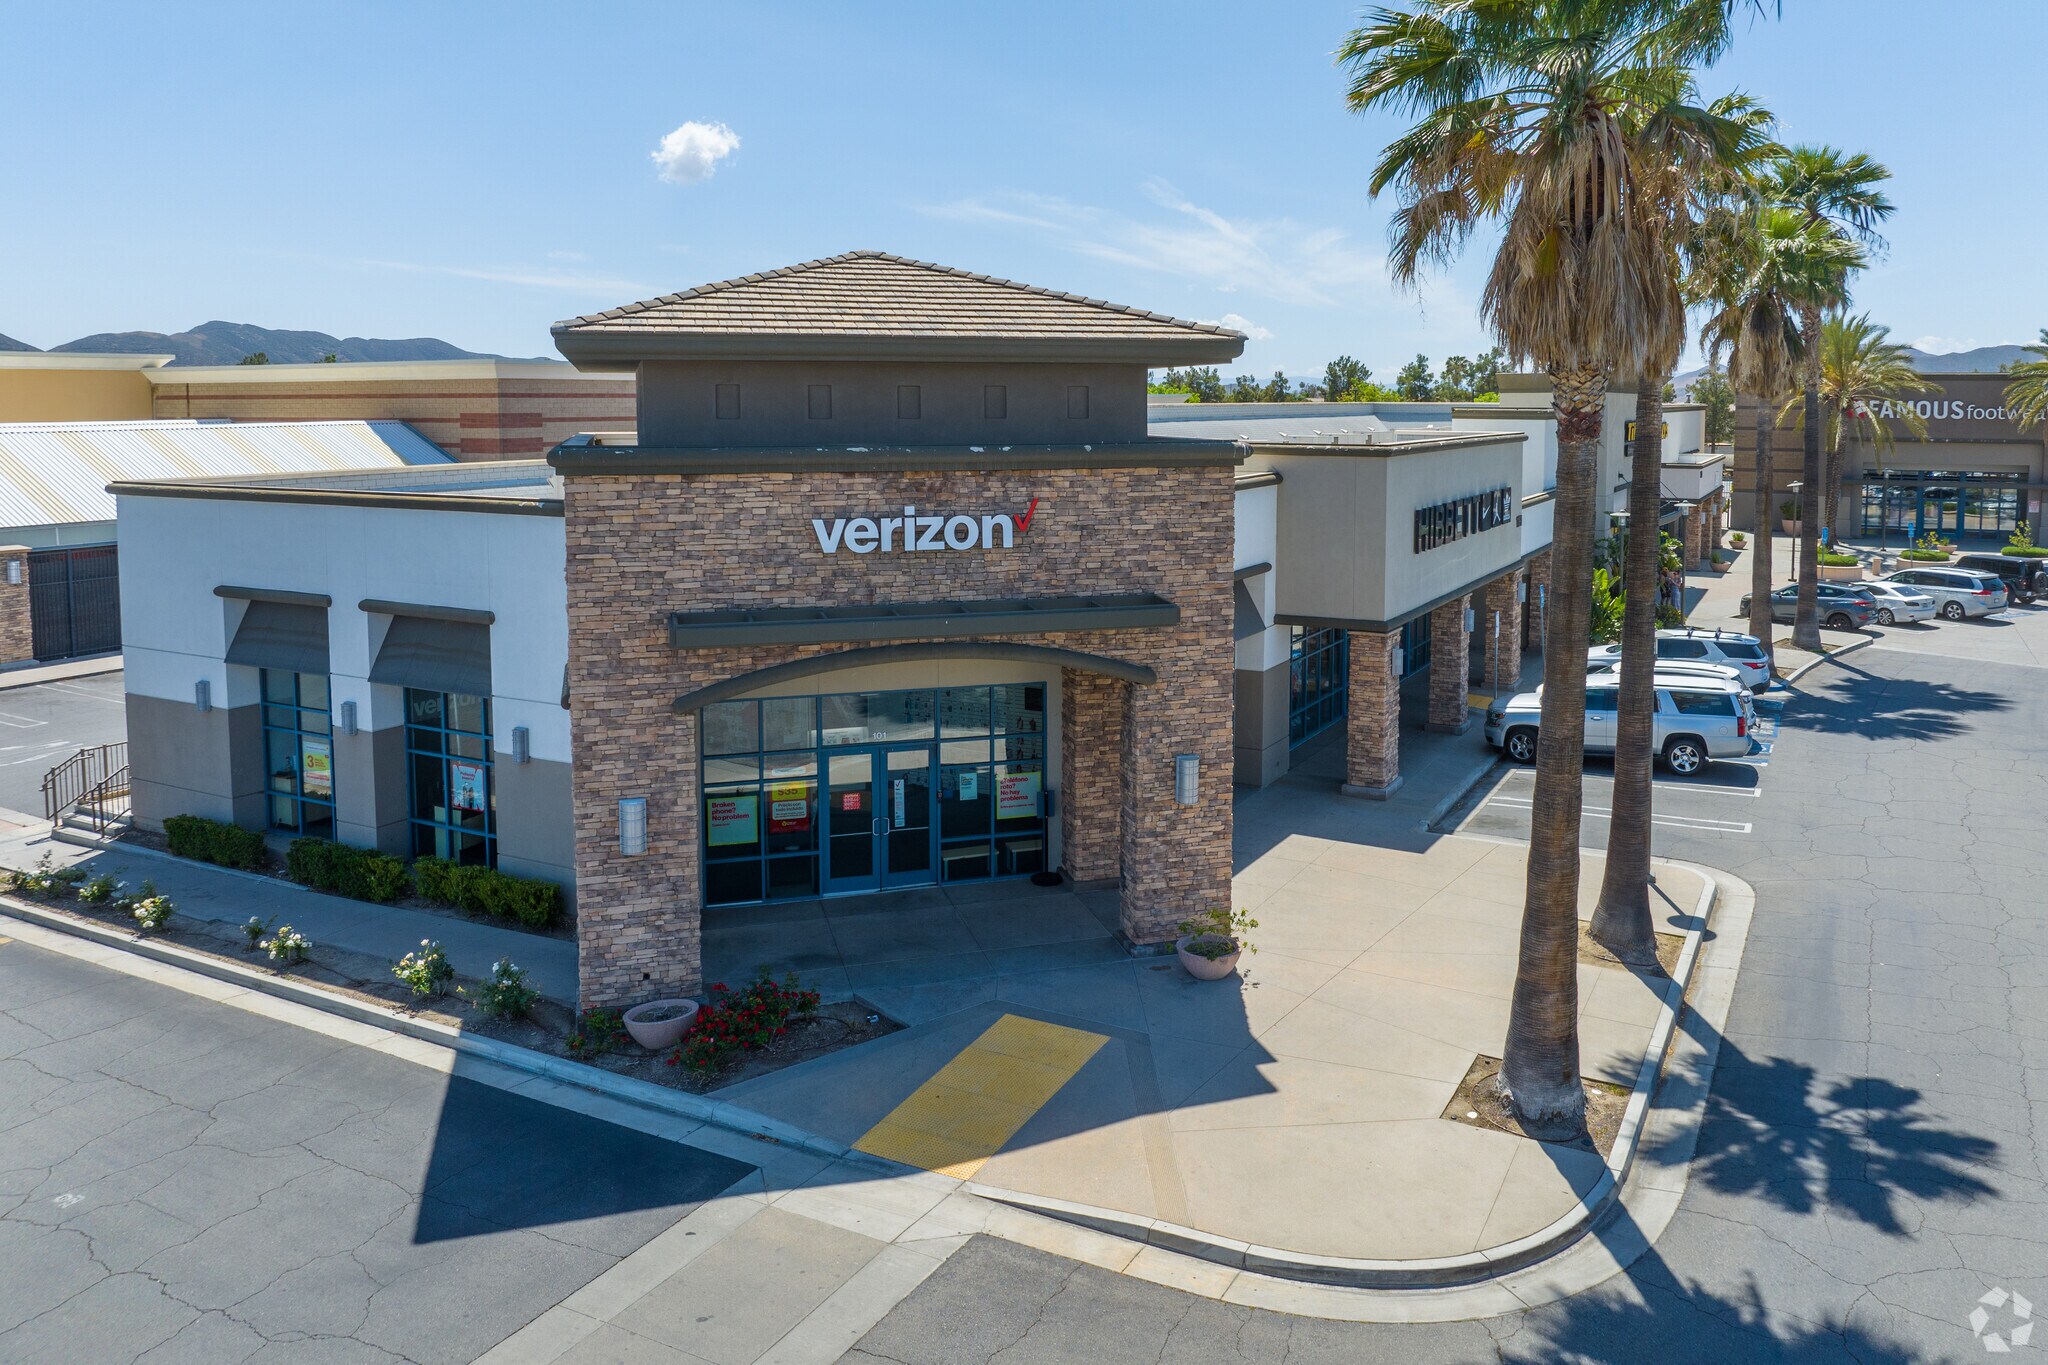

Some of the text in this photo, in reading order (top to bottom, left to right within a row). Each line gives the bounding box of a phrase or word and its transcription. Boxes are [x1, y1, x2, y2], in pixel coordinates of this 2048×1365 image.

[1869, 400, 1965, 420] FAMOUS
[812, 505, 1014, 554] verizon
[1414, 493, 1481, 555] HIBBETT
[872, 731, 887, 740] 101
[306, 754, 315, 768] 3
[711, 807, 736, 815] phone?
[722, 813, 749, 821] problem
